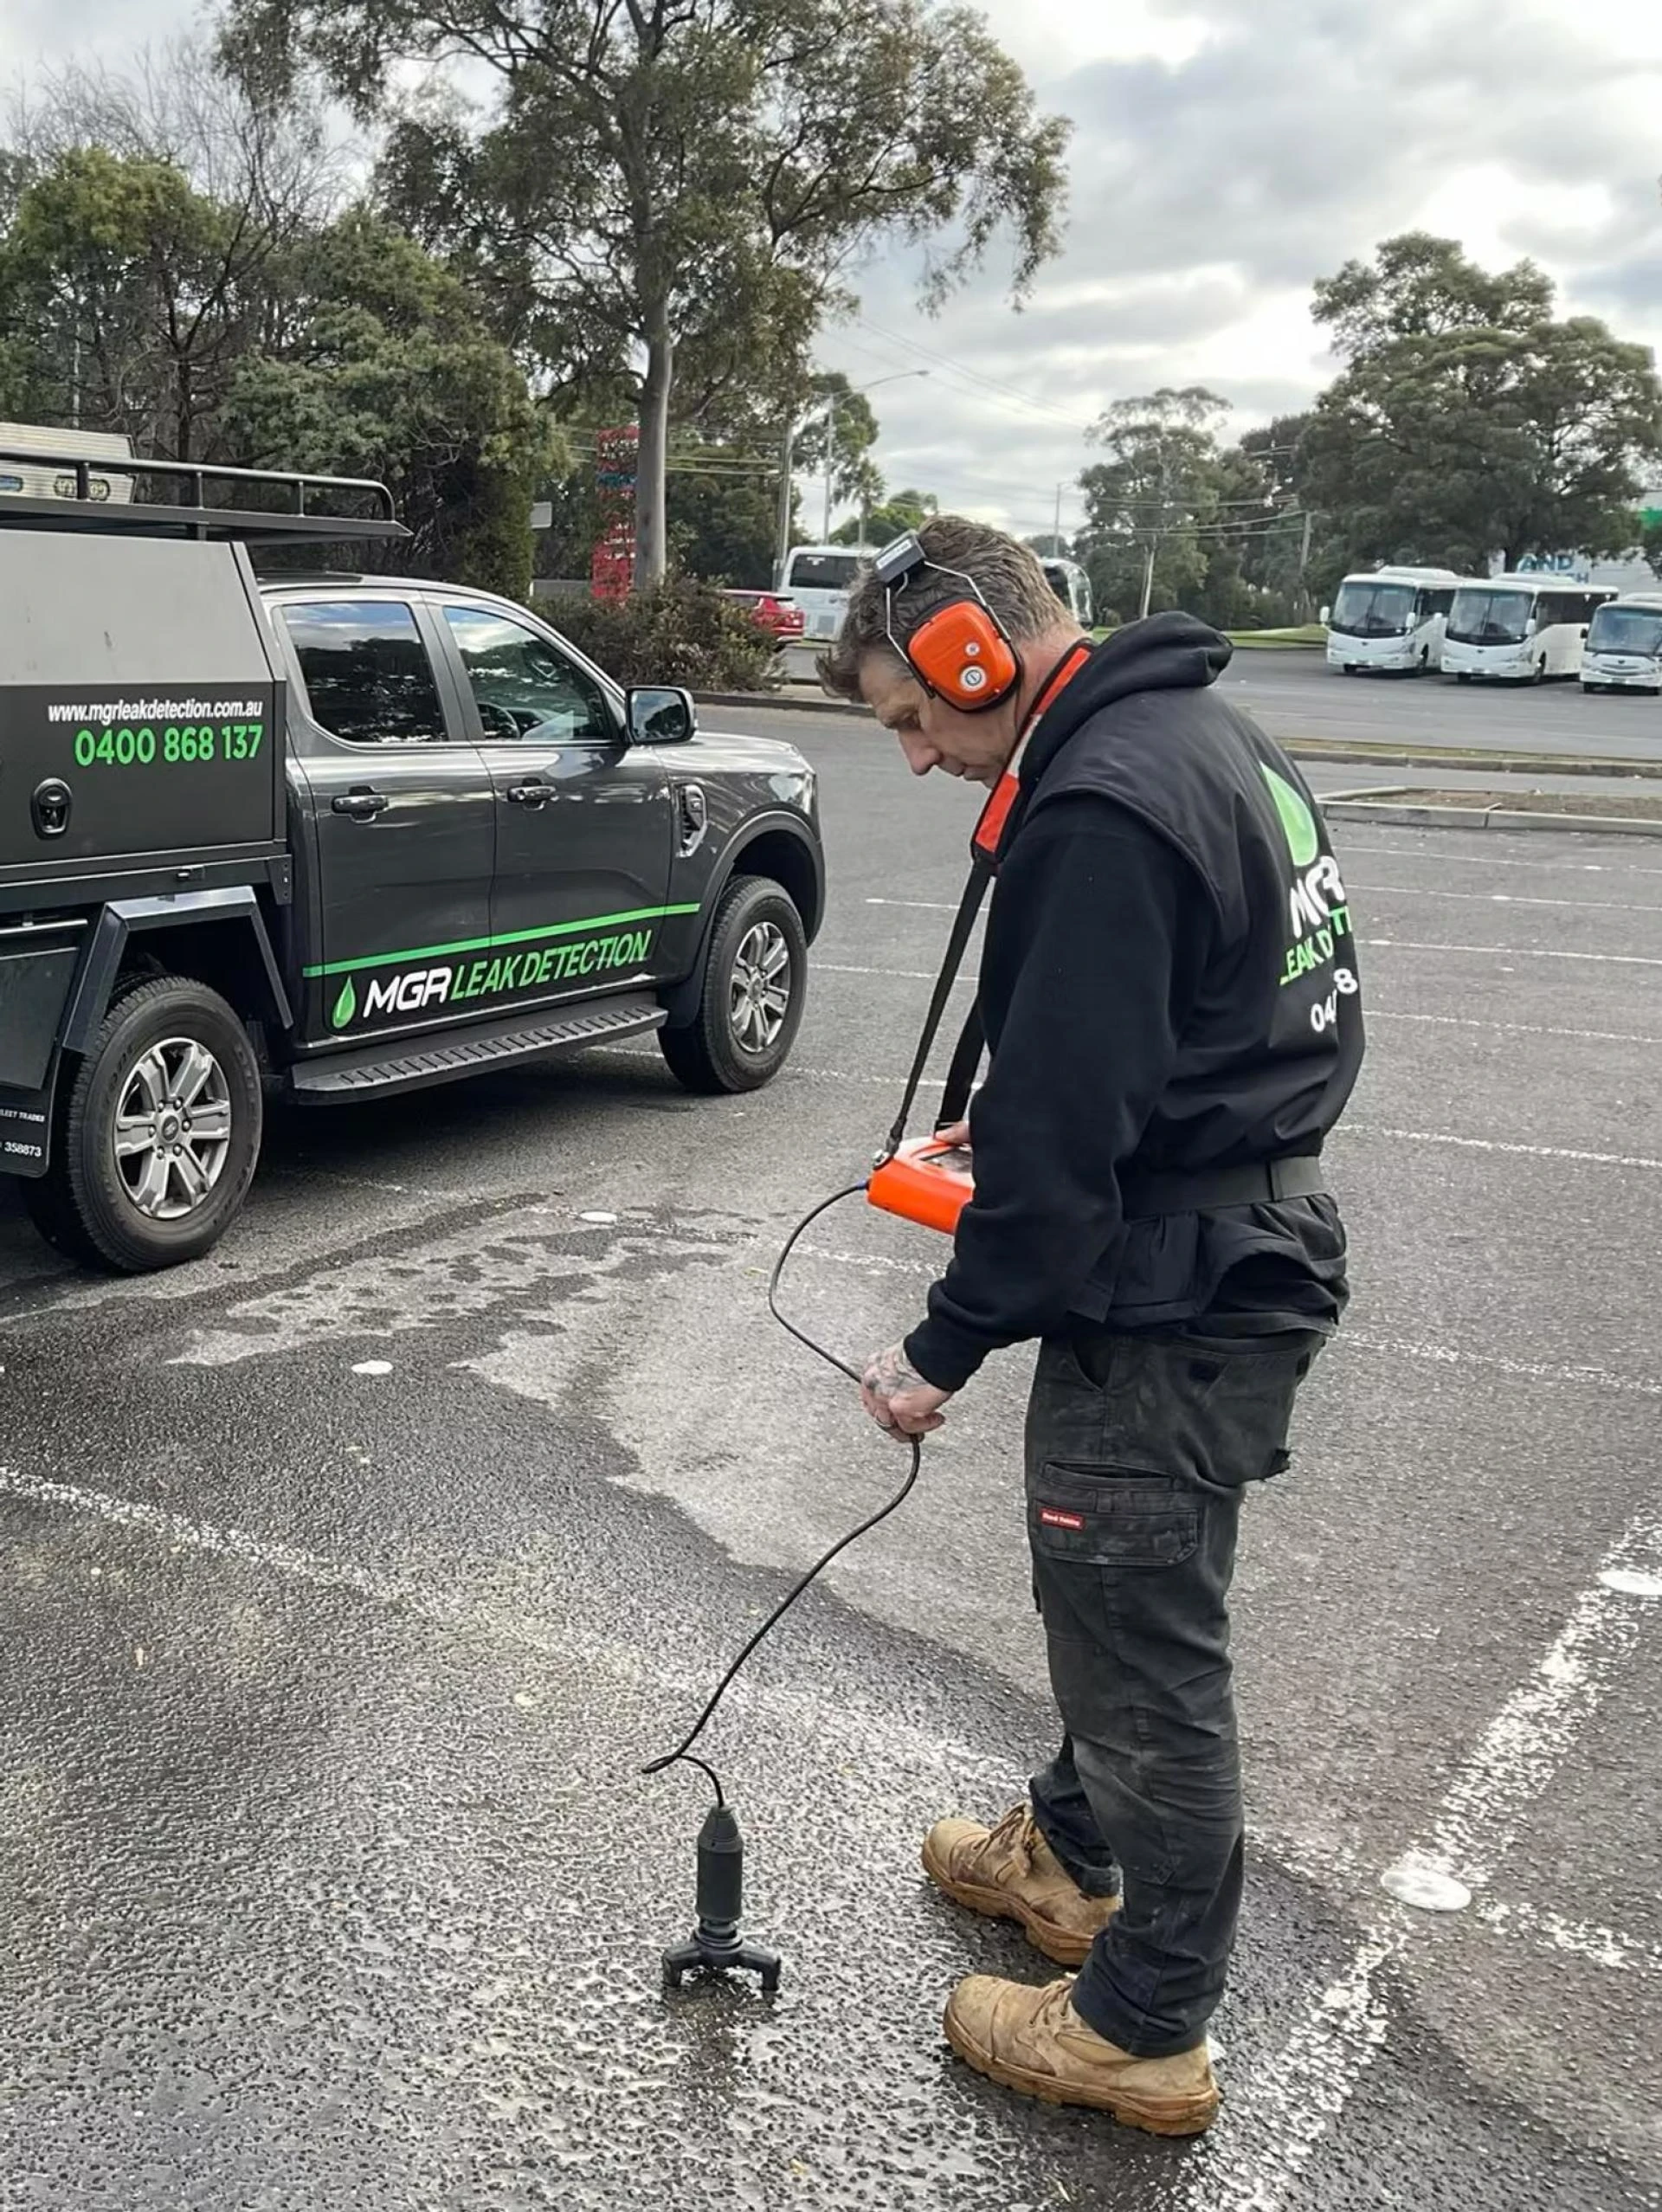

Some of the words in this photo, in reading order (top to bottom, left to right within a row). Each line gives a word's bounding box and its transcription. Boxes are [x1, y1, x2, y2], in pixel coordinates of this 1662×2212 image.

[48, 698, 263, 726] www.mgrleakdetection.com.au
[74, 727, 156, 766] 0400
[164, 726, 215, 762] 868
[221, 725, 263, 759] 137
[363, 967, 451, 1017] MGR
[450, 954, 521, 1002] LEAK
[519, 931, 652, 987] DETECTION
[4, 1141, 42, 1157] 358873
